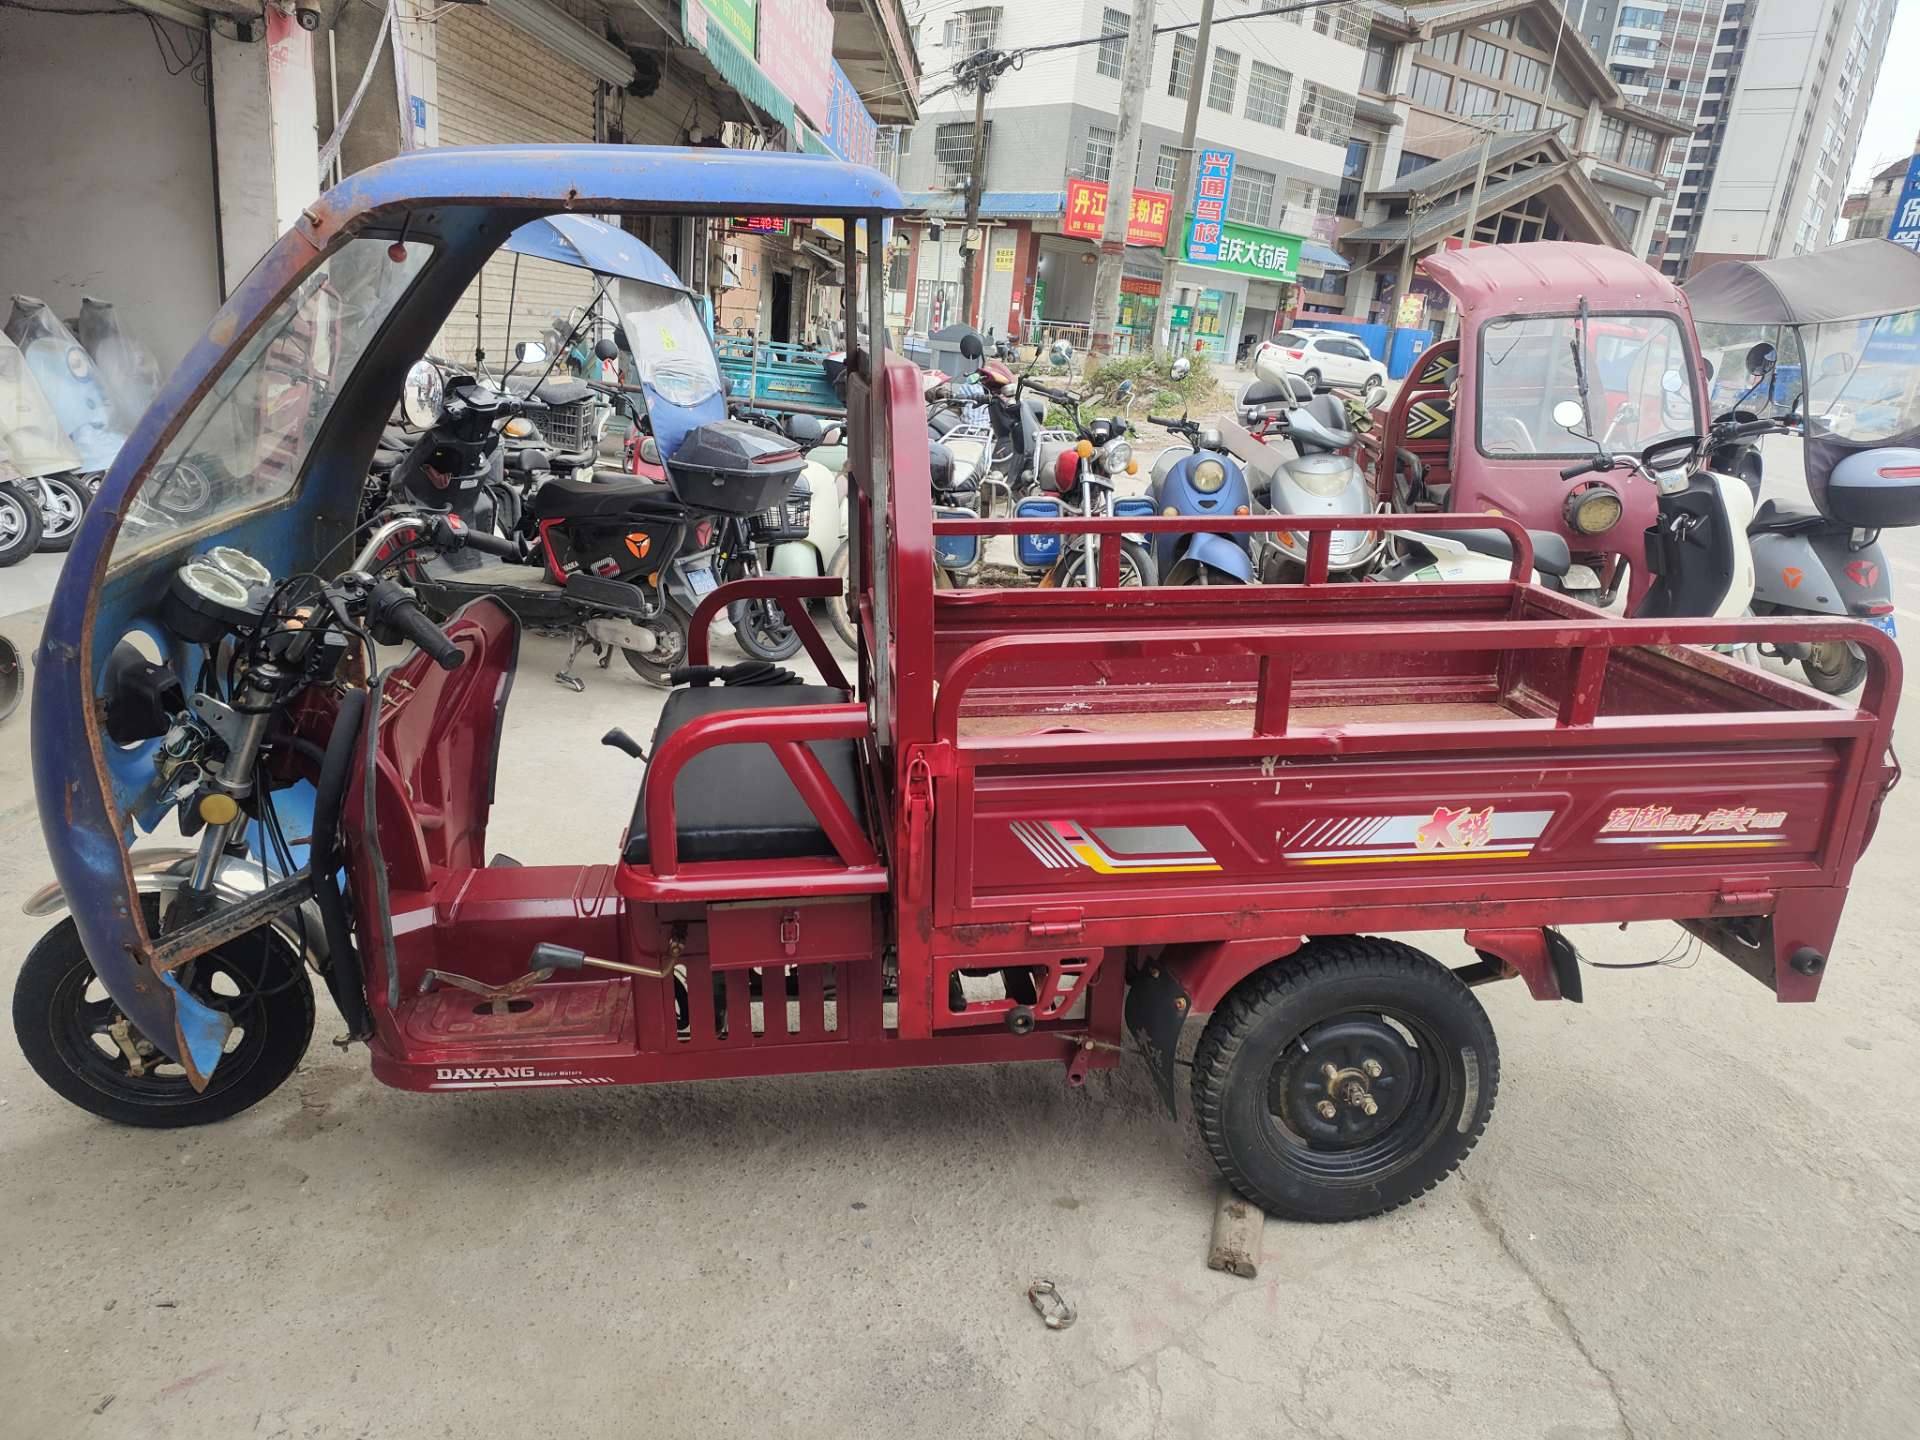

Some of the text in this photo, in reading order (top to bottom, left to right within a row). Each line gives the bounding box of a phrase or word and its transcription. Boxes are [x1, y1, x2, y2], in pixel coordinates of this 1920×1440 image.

[1194, 152, 1231, 244] 兴通驾校
[436, 1066, 535, 1080] DAYANG
